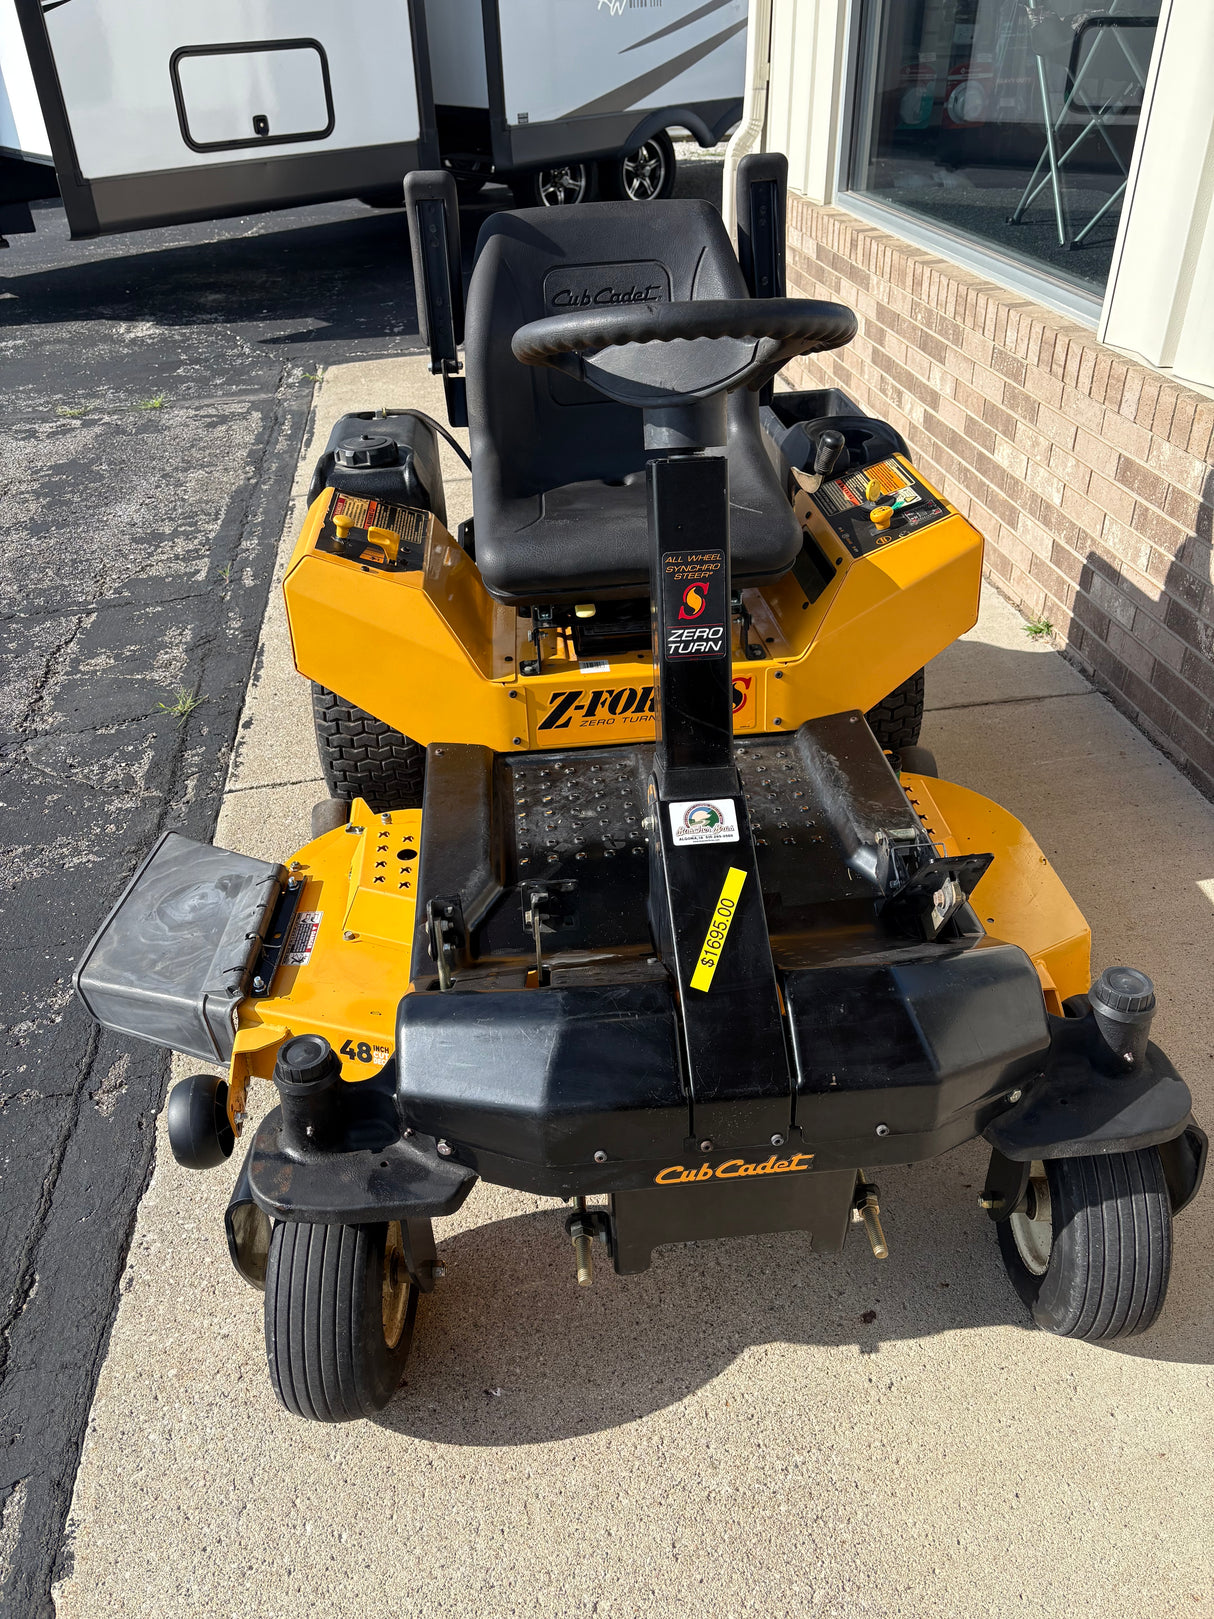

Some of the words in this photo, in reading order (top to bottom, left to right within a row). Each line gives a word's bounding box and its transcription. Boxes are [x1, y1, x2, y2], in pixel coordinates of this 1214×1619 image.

[552, 288, 592, 306] Cub
[593, 284, 662, 305] Cadet
[687, 553, 722, 562] WHEEL
[665, 563, 721, 573] SYNCHRO
[667, 627, 724, 641] ZERO
[667, 640, 722, 654] TURN
[537, 686, 655, 730] Z-FOR
[579, 717, 616, 727] ZERO
[700, 898, 735, 968] $1695.00
[339, 1039, 373, 1063] 48
[373, 1044, 390, 1054] INCH
[373, 1051, 390, 1060] CUT
[373, 1058, 386, 1066] DEC
[655, 1163, 714, 1185] Cub
[715, 1153, 815, 1178] Cadet
